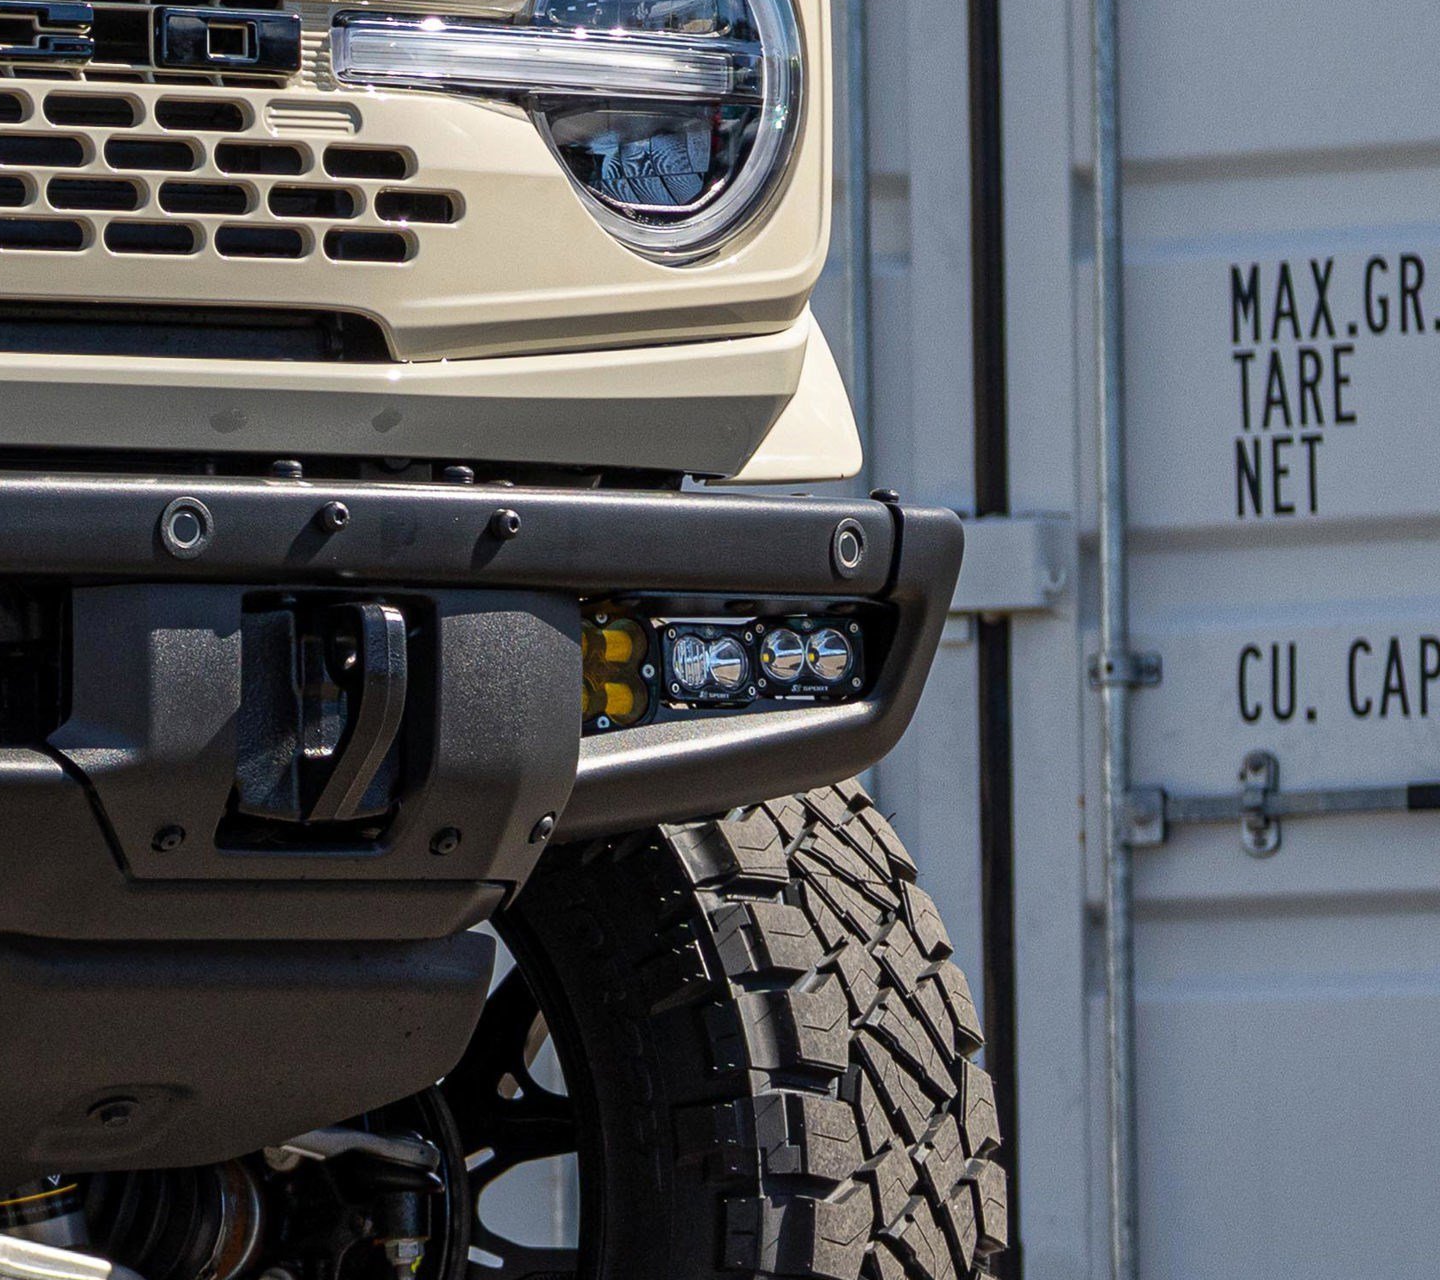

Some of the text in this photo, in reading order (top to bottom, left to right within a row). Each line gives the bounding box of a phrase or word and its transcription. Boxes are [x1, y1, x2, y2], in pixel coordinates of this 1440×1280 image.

[1233, 343, 1357, 431] TARE
[1236, 433, 1323, 517] NET
[1238, 642, 1317, 722] CU.
